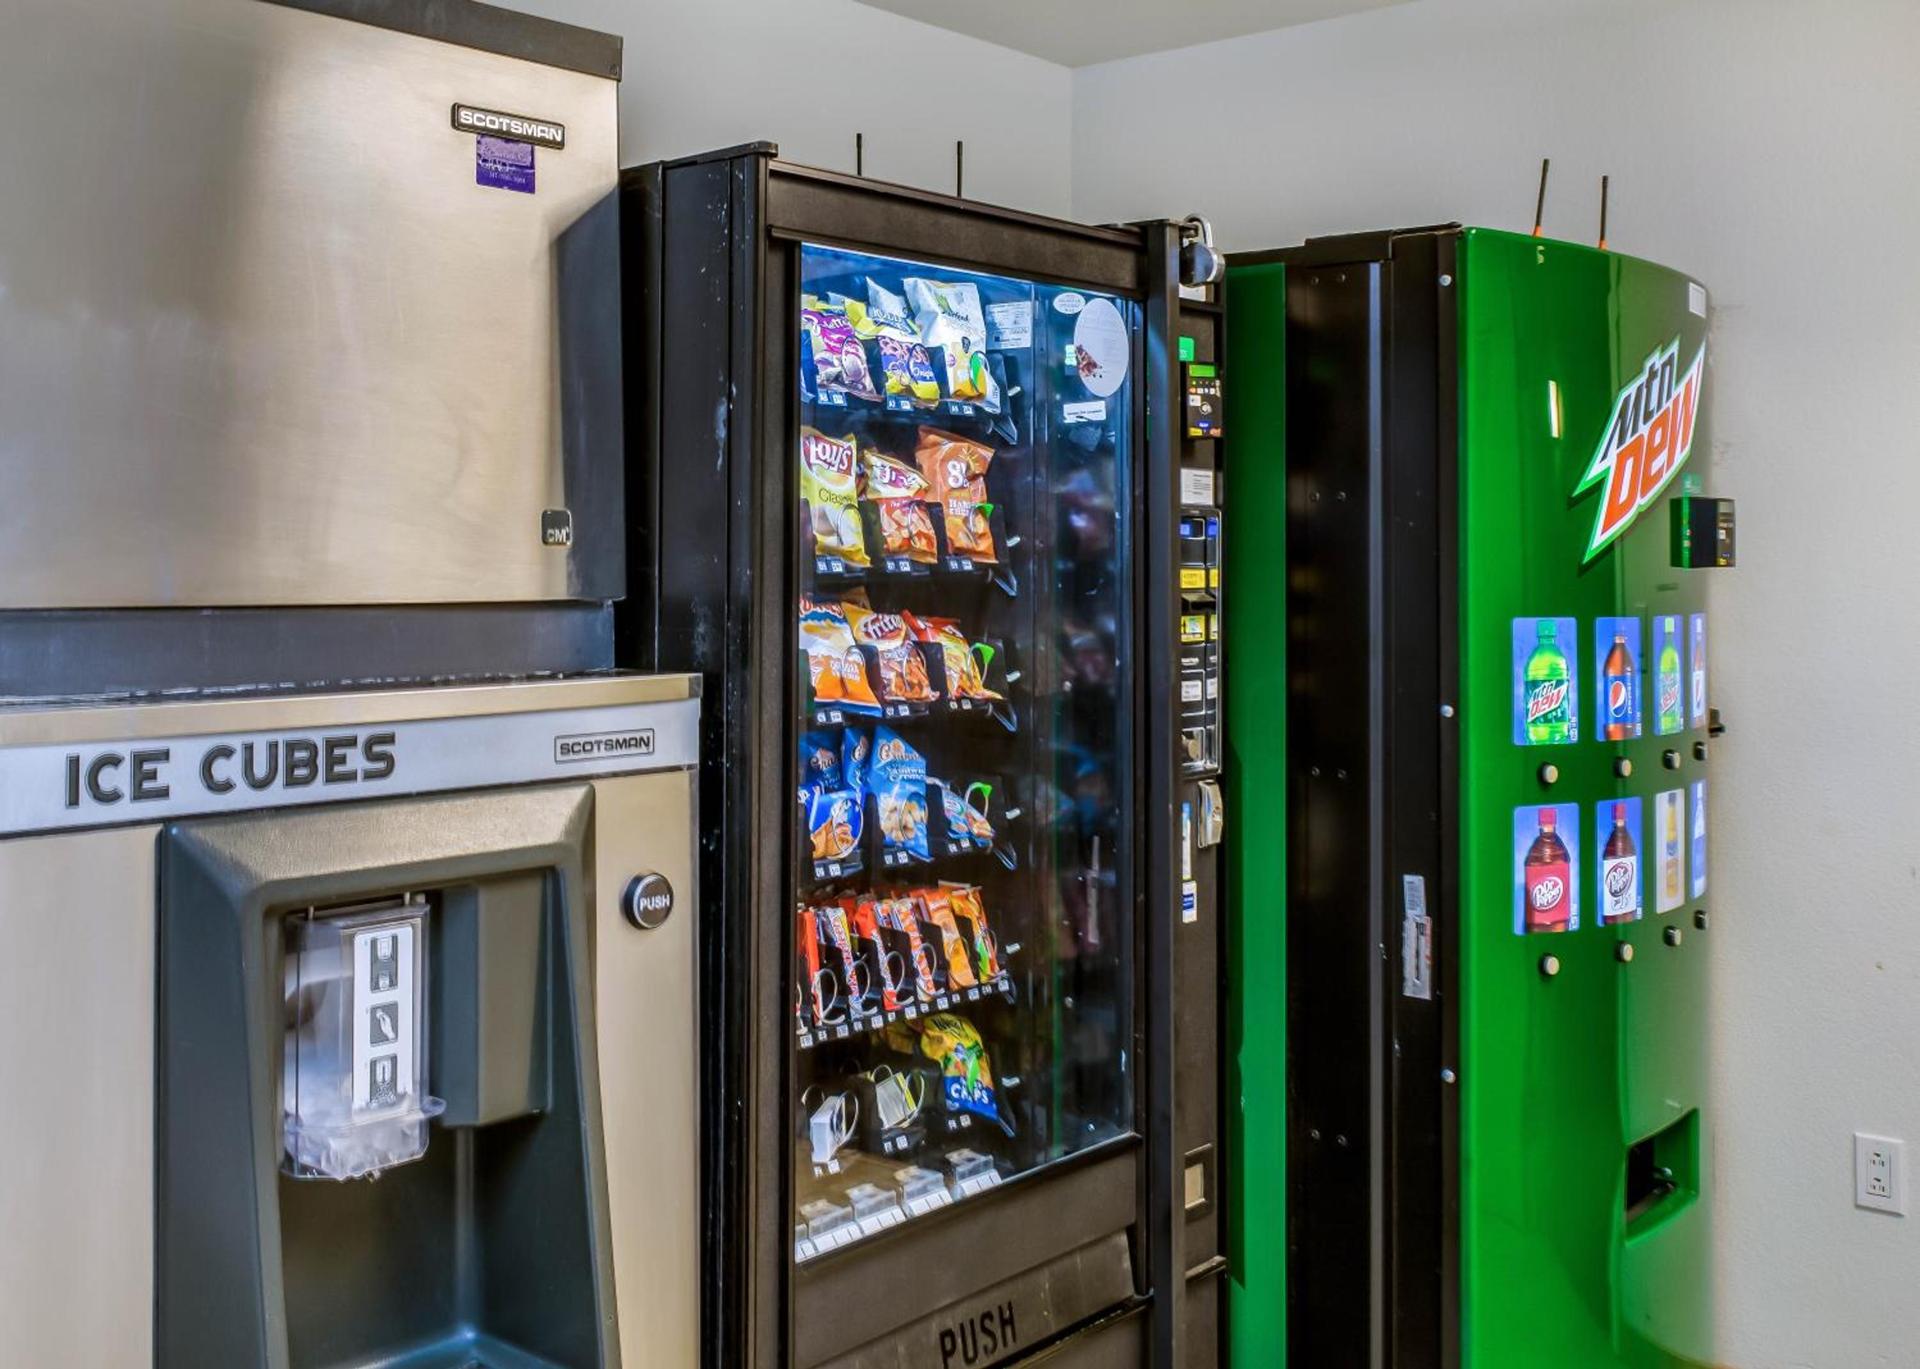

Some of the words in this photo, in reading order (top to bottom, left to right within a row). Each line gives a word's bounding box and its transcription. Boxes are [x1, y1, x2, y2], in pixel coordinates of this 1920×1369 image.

[460, 110, 562, 142] SCOTSMAN
[1599, 351, 1676, 465] Mtn
[65, 747, 170, 810] ICE
[200, 730, 397, 794] CUBES
[560, 735, 651, 757] SCOTSMAN
[639, 894, 671, 912] PUSH
[939, 1299, 1017, 1369] PUSH
